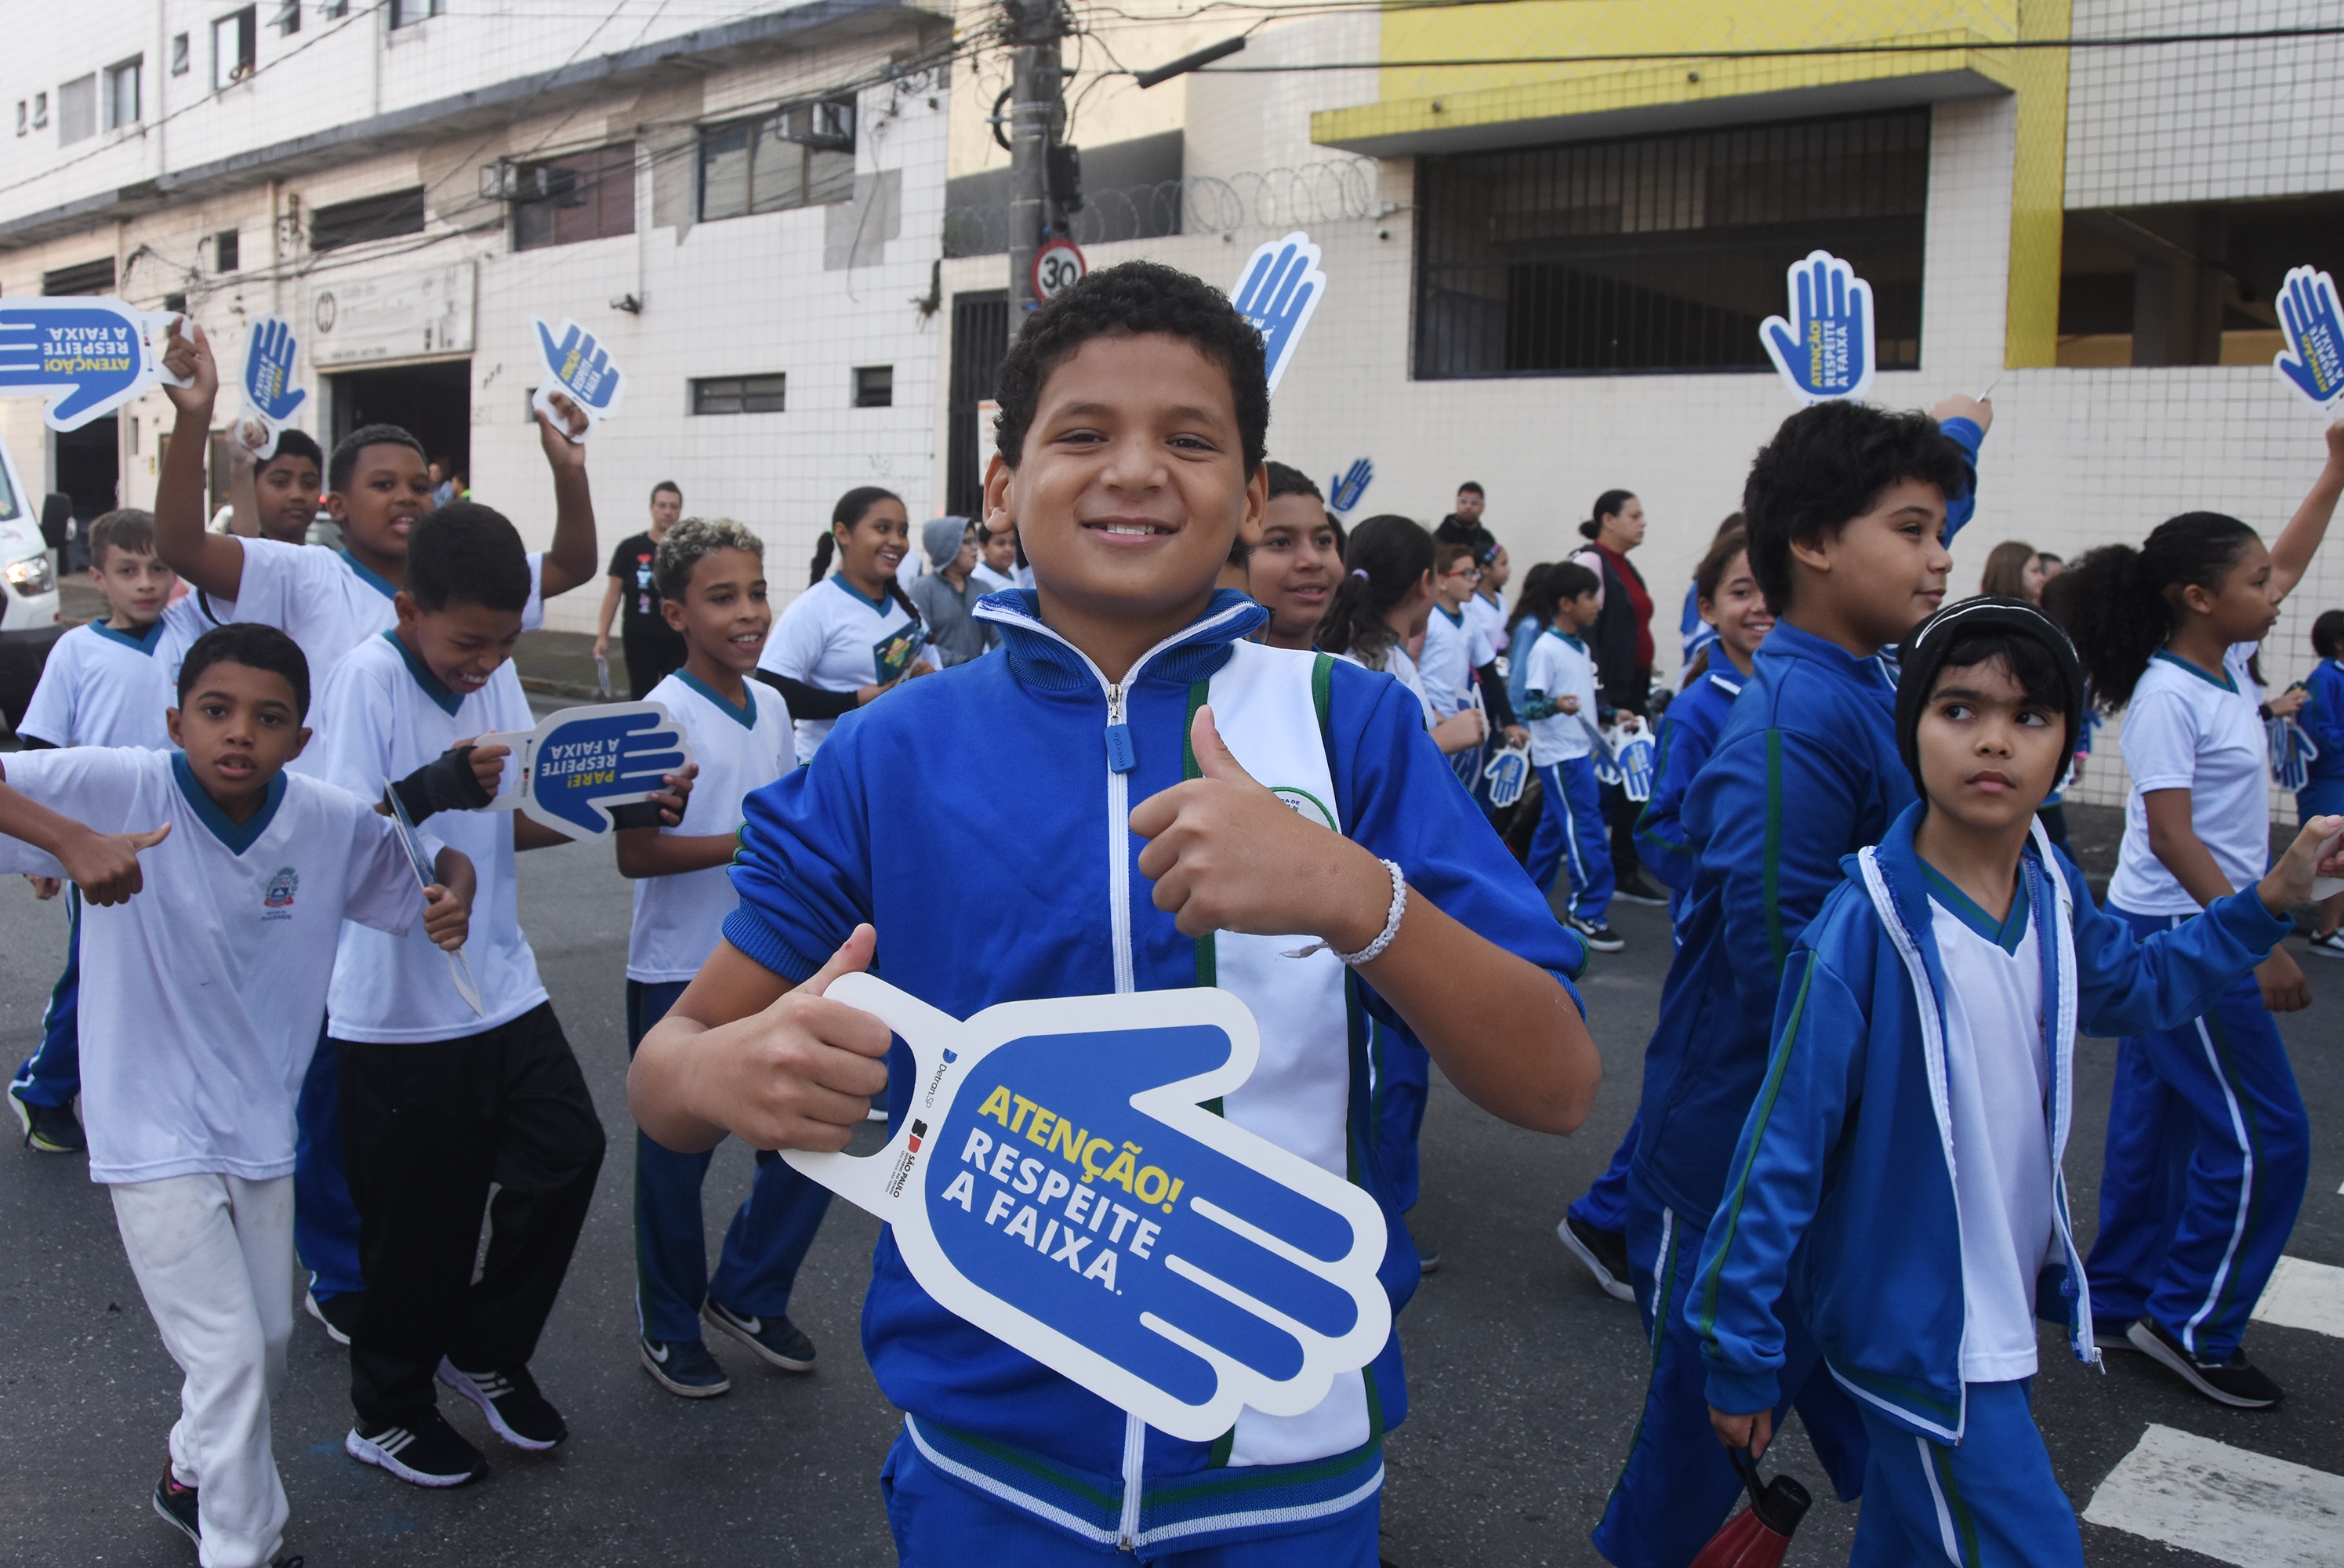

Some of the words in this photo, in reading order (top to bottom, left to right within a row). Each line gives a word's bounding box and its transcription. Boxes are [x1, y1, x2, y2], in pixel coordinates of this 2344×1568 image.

[1043, 256, 1076, 289] 30
[45, 327, 108, 341] FAIXA.
[113, 327, 127, 339] A
[43, 342, 129, 355] RESPEITE
[1807, 321, 1823, 387] ATENÇÃO!
[1823, 321, 1837, 387] RESPEITE
[2309, 325, 2338, 387] RESPEITE
[44, 355, 130, 374] ATENÇÃO!
[1837, 376, 1849, 387] A
[608, 738, 620, 751] A
[541, 754, 617, 776] RESPEITE
[567, 770, 615, 788] PARE!
[925, 1063, 947, 1108] Detran.SP
[978, 1085, 1185, 1214] ATENÇÃO!
[904, 1155, 916, 1173] SÃO
[892, 1171, 908, 1199] PAULO
[960, 1127, 1162, 1259] RESPEITE
[942, 1171, 974, 1212] A
[985, 1189, 1122, 1296] FAIXA.
